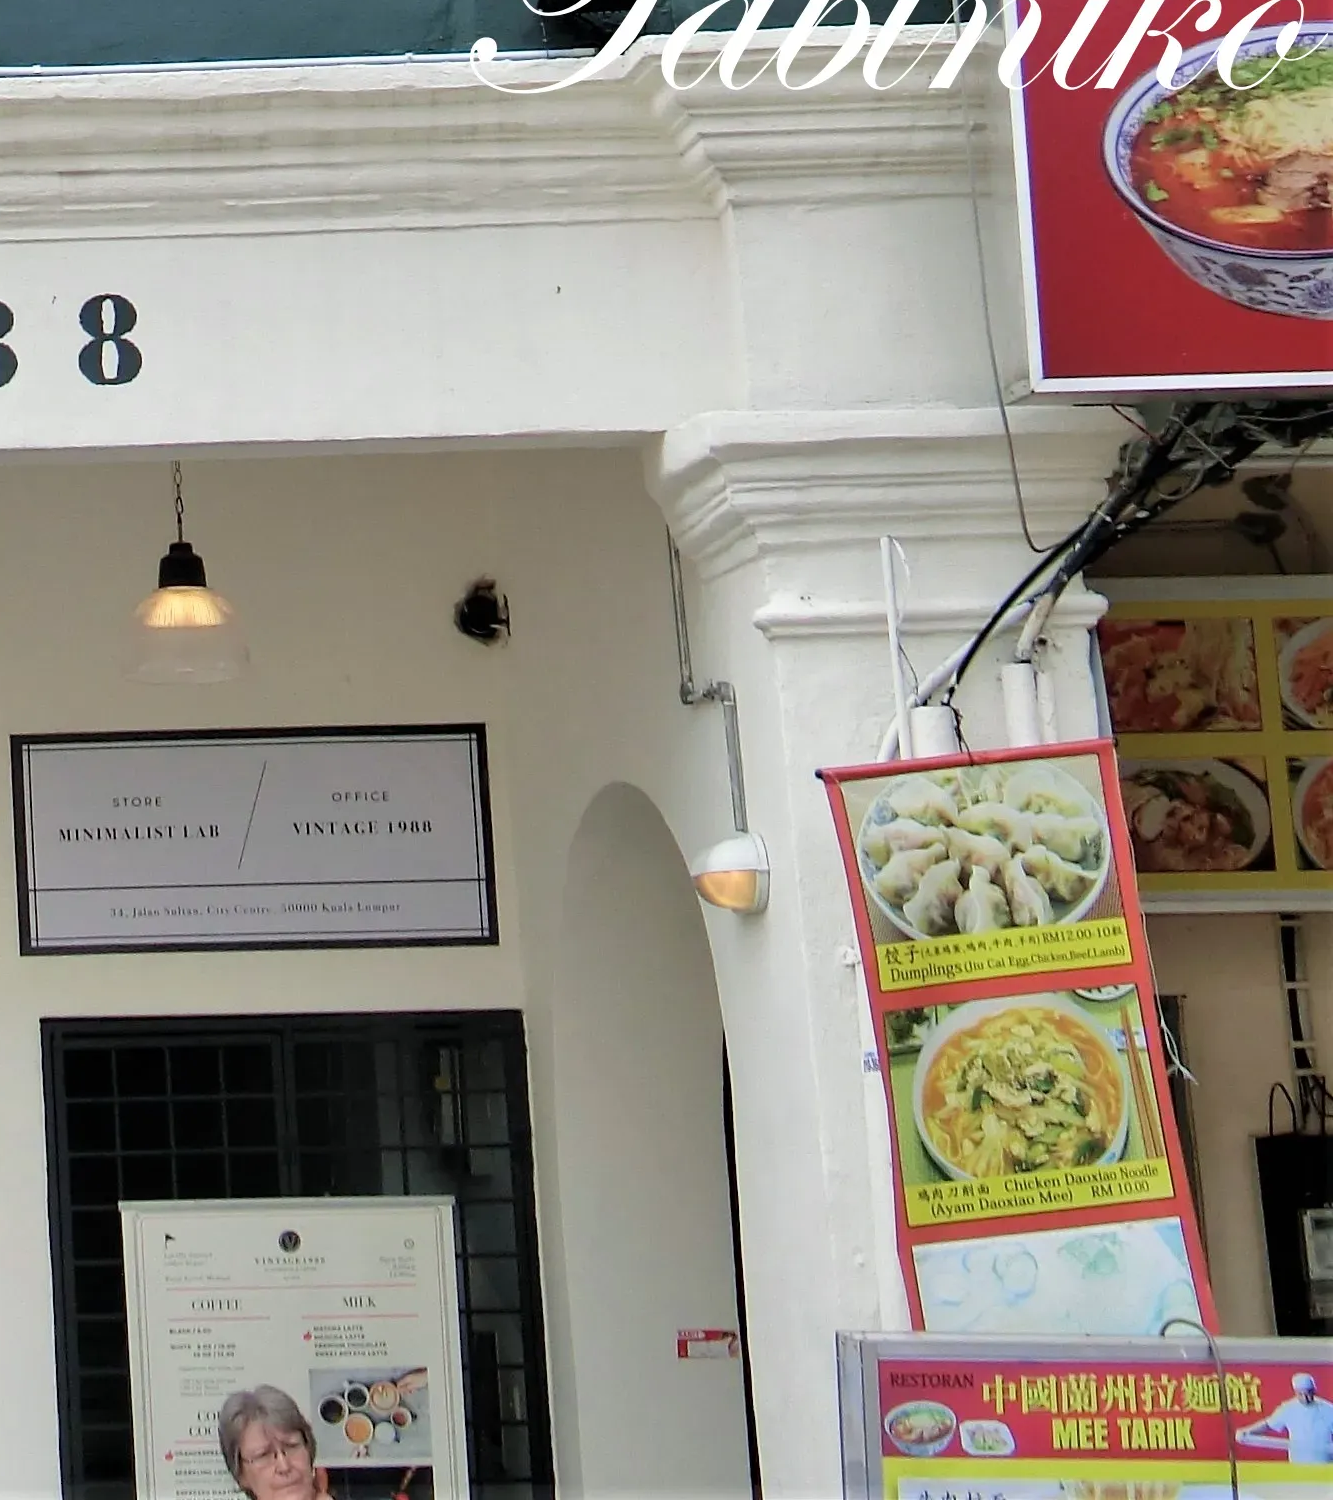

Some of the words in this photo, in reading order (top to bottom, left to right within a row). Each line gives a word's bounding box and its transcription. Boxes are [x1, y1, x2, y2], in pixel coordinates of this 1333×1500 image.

[112, 796, 162, 808] STORE
[331, 790, 390, 803] OFFICE
[58, 824, 176, 842] MINIMALIST
[183, 823, 220, 840] LAB
[292, 820, 379, 836] VINTAGE
[387, 819, 433, 834] 1988
[891, 963, 963, 982] Dumplings
[1004, 1177, 1061, 1194] Chicken
[1065, 1170, 1117, 1187] Daoxiao
[1121, 1164, 1159, 1180] Noodle
[931, 1202, 975, 1219] (Ayam
[1039, 1188, 1074, 1205] Mee)
[1091, 1184, 1113, 1199] RM
[1118, 1180, 1150, 1196] 10.00
[891, 1371, 974, 1390] RESTORAN
[1052, 1418, 1109, 1451] MEE
[1117, 1417, 1196, 1451] TARIK
